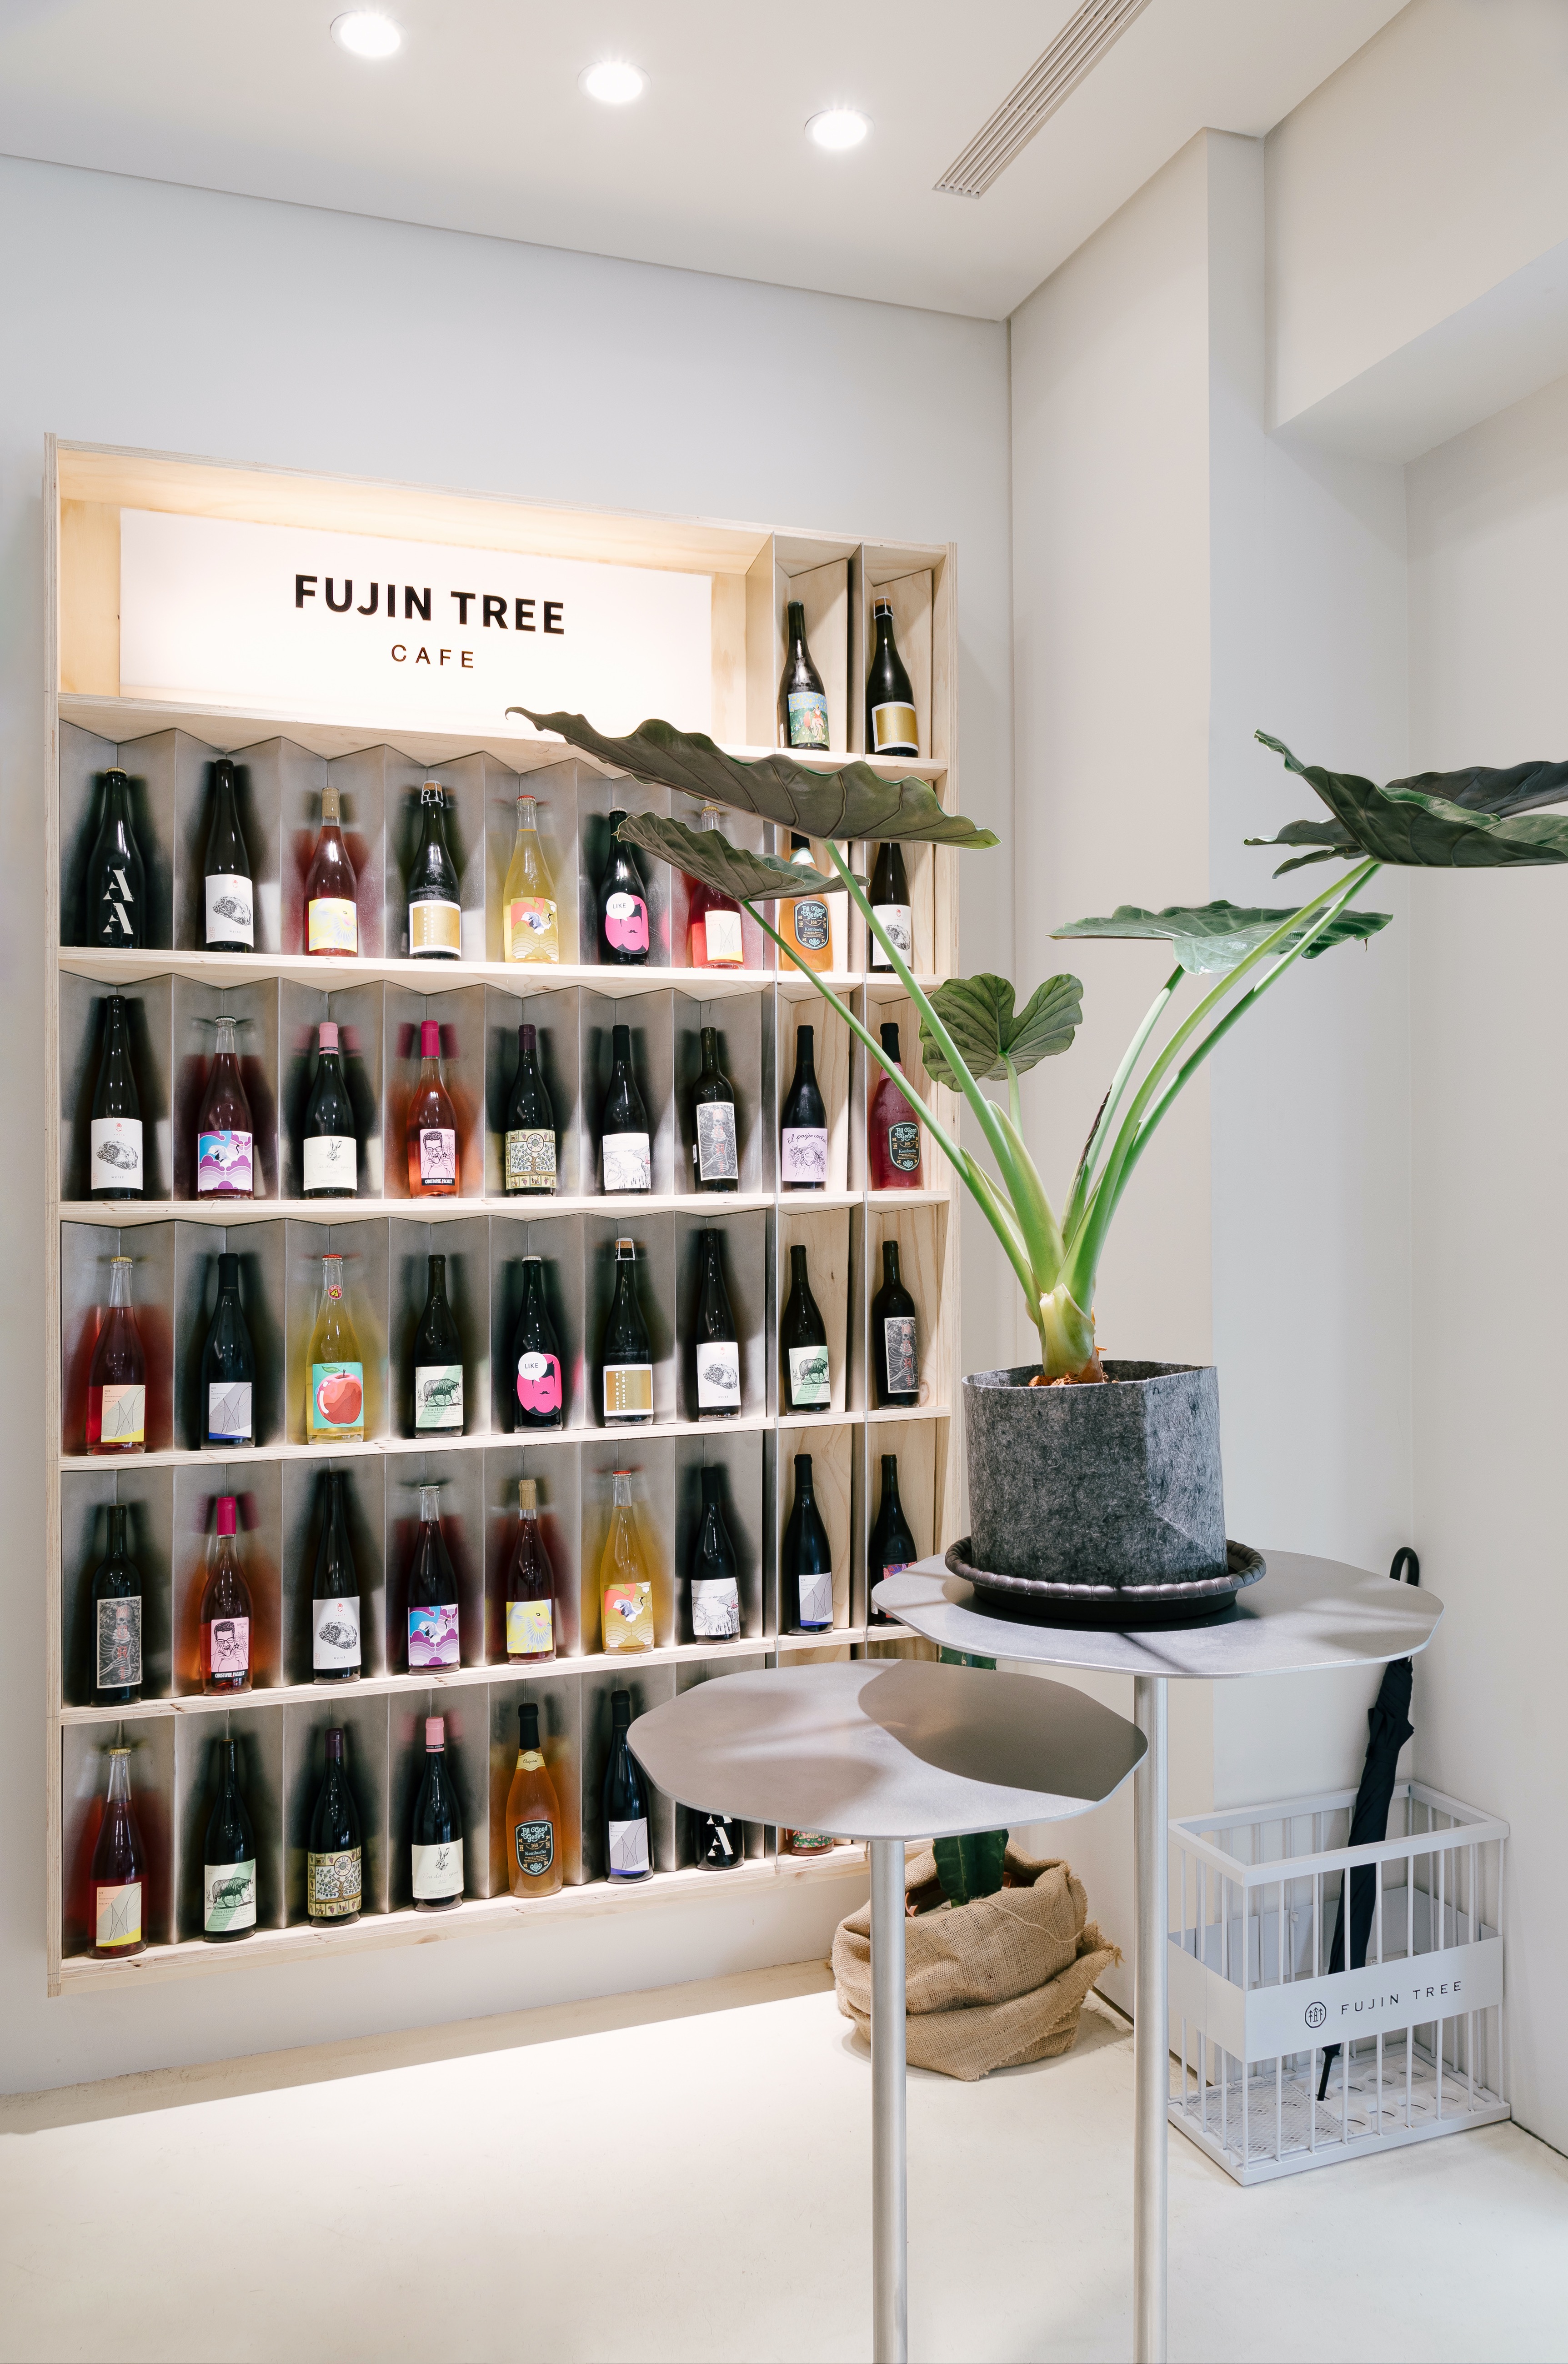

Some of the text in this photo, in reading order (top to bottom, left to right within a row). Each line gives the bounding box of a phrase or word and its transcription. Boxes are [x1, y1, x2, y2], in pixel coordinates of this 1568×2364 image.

[296, 574, 564, 635] FUJIN TREE
[391, 644, 474, 669] CAFE
[801, 906, 825, 914] All Good
[894, 1127, 917, 1136] All Good
[787, 1134, 794, 1144] El
[521, 1824, 548, 1837] All Good
[523, 1833, 545, 1843] Gene's
[335, 1857, 351, 1874] MENDALL
[1341, 1980, 1462, 2015] FUJIN TREE
